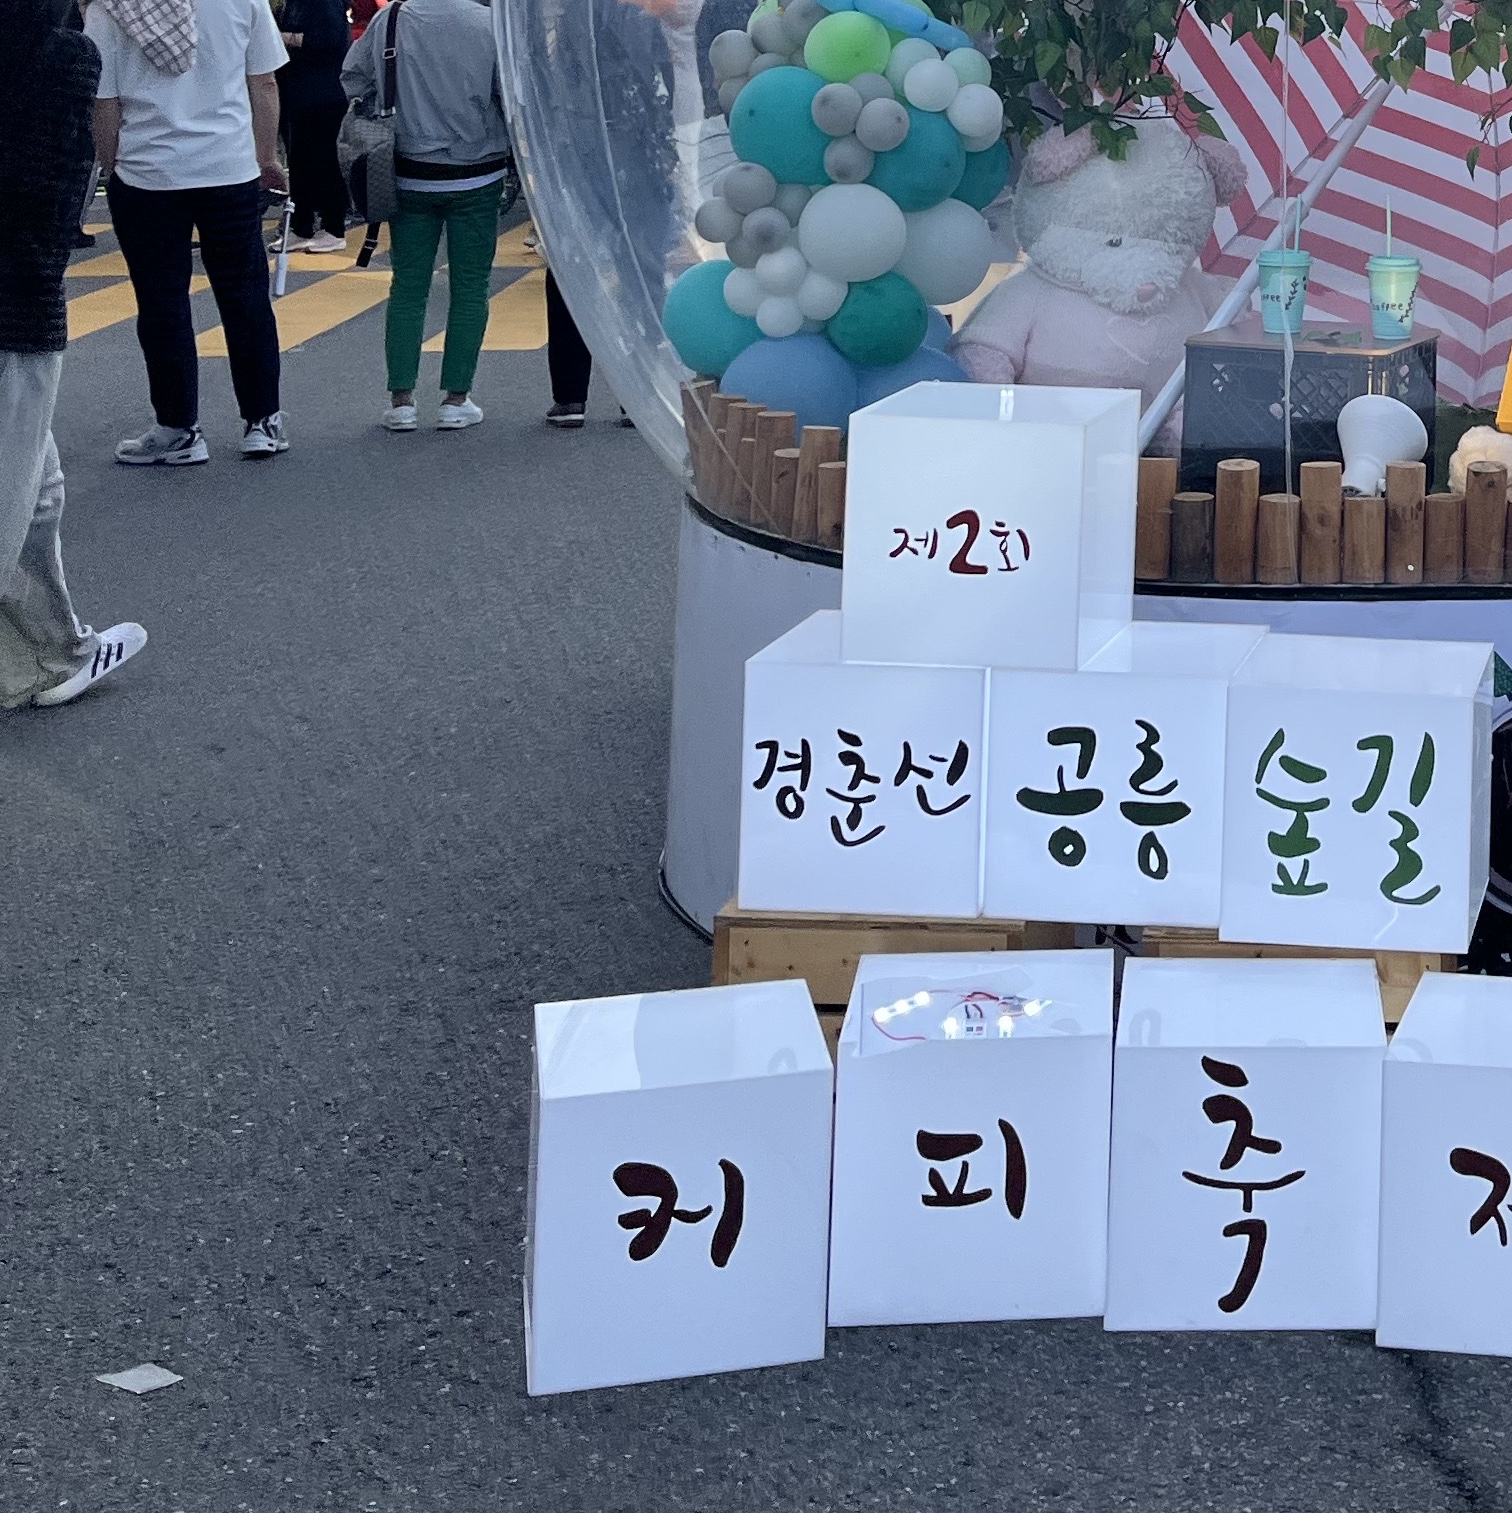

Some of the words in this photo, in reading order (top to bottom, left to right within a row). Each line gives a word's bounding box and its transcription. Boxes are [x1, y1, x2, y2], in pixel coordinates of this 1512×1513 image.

[889, 509, 1031, 576] 제2회
[751, 727, 973, 848] 경춘선
[1015, 718, 1192, 881] 공릉
[1255, 727, 1442, 906] 숲길
